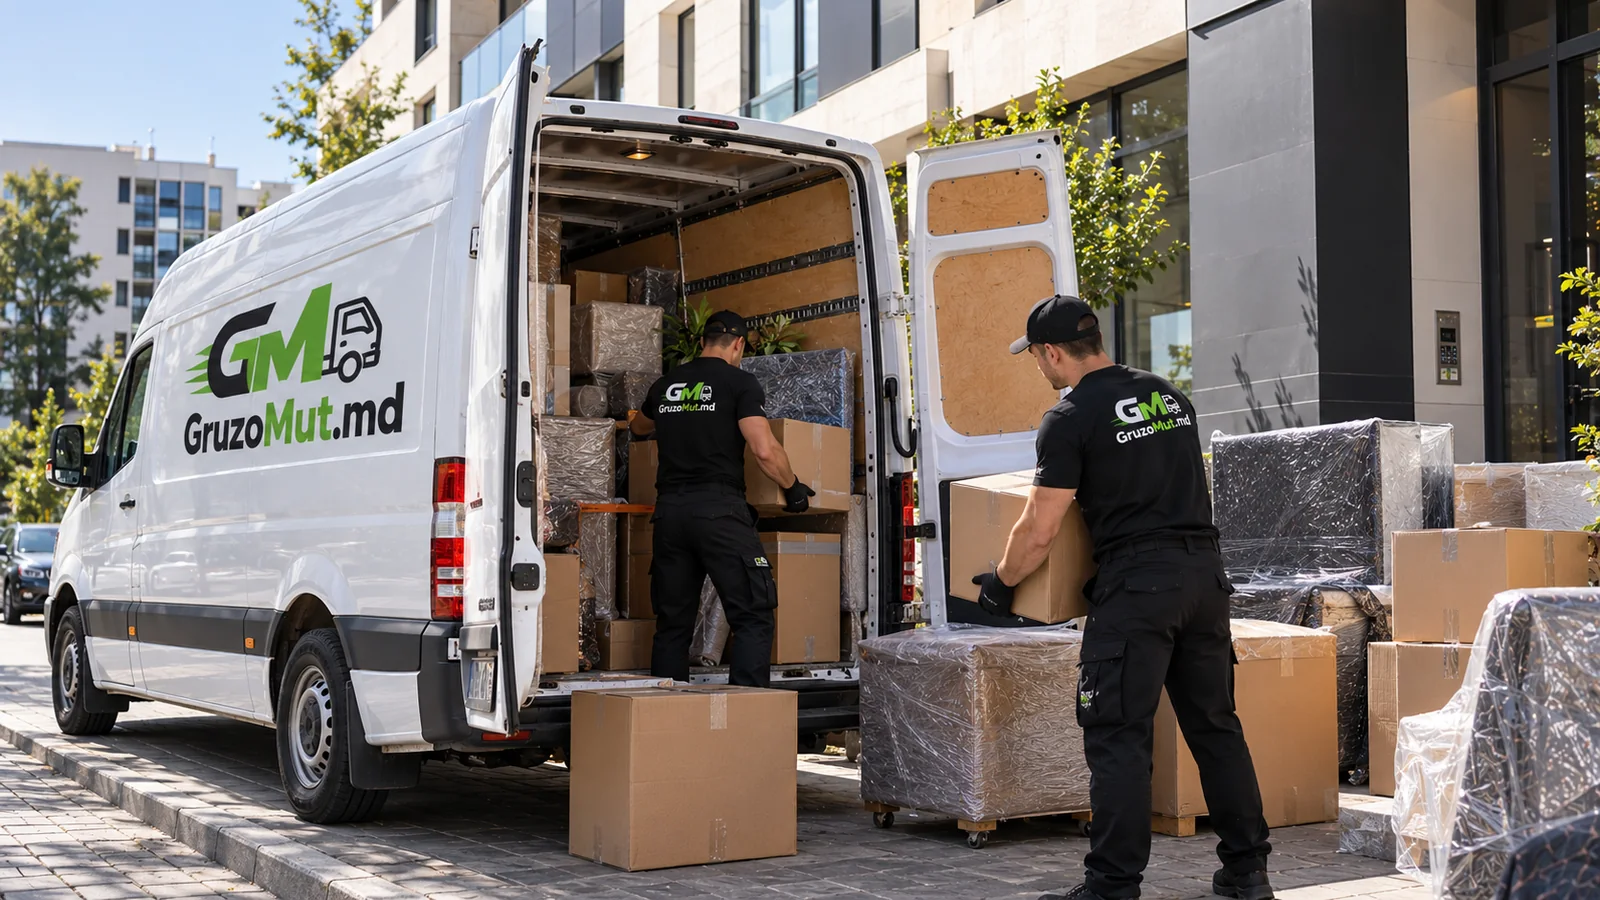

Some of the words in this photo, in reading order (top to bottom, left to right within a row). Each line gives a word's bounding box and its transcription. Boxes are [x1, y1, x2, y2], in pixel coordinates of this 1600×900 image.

[207, 282, 333, 399] GM
[665, 381, 705, 402] GM
[1114, 391, 1169, 424] GM
[184, 381, 405, 455] GruzoMut.md
[658, 402, 716, 414] GruzoMut.md
[1116, 413, 1192, 444] GruzoMut.md
